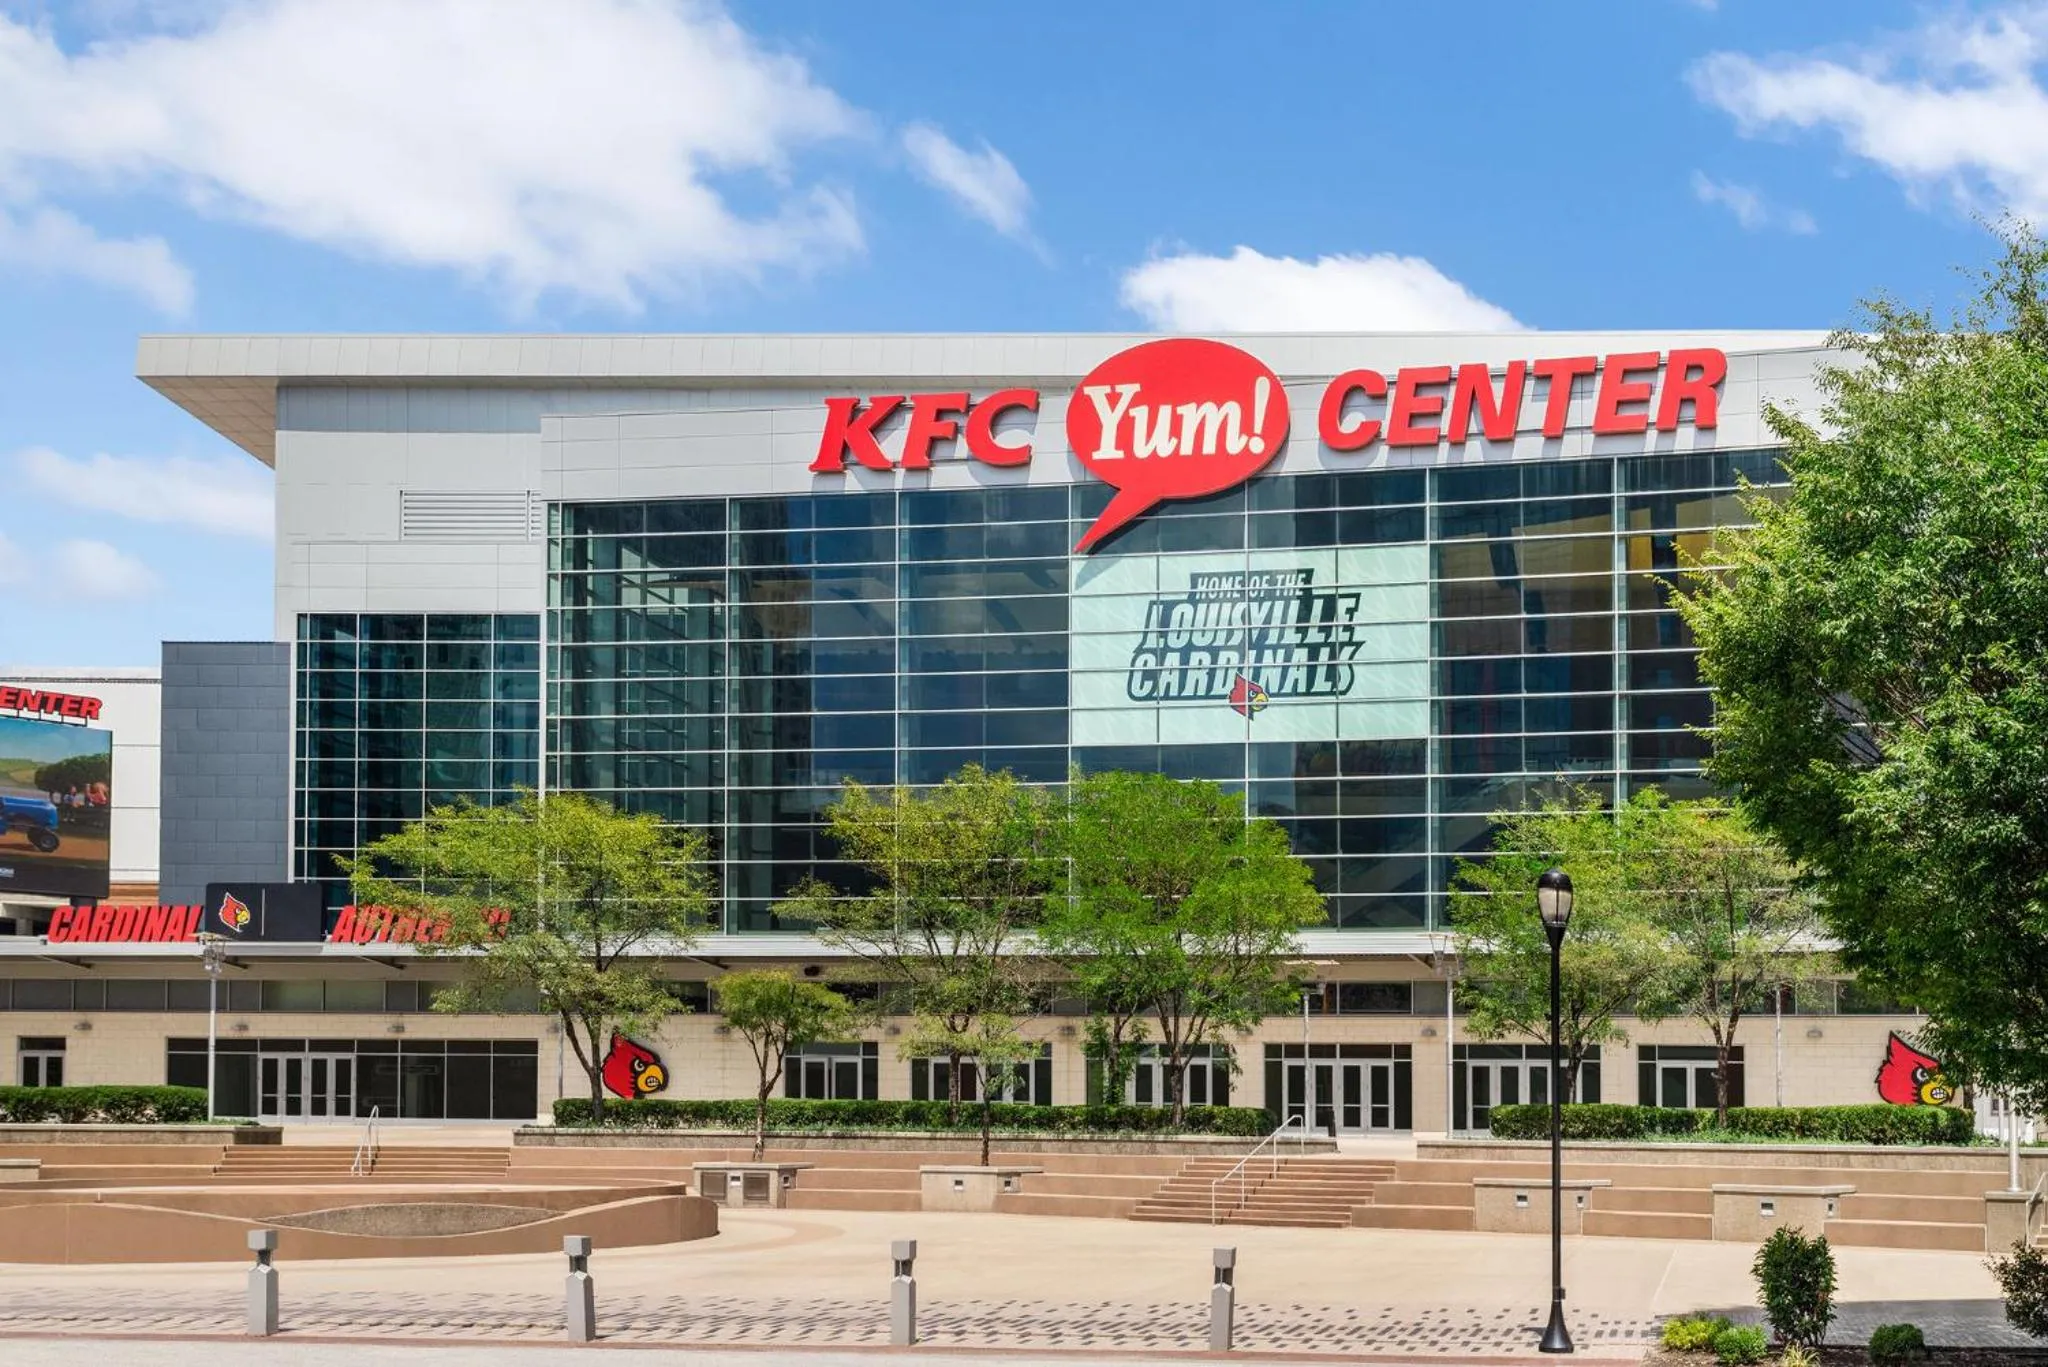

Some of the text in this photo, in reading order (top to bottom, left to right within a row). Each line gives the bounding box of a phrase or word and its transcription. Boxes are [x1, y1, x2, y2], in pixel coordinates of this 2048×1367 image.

[809, 347, 1728, 473] KFC Yum! CENTER
[1196, 573, 1307, 600] HOME OF THE
[1141, 595, 1358, 650] LOUISVILLE
[1131, 645, 1358, 699] CARDINALS
[47, 904, 204, 943] CARDINAL
